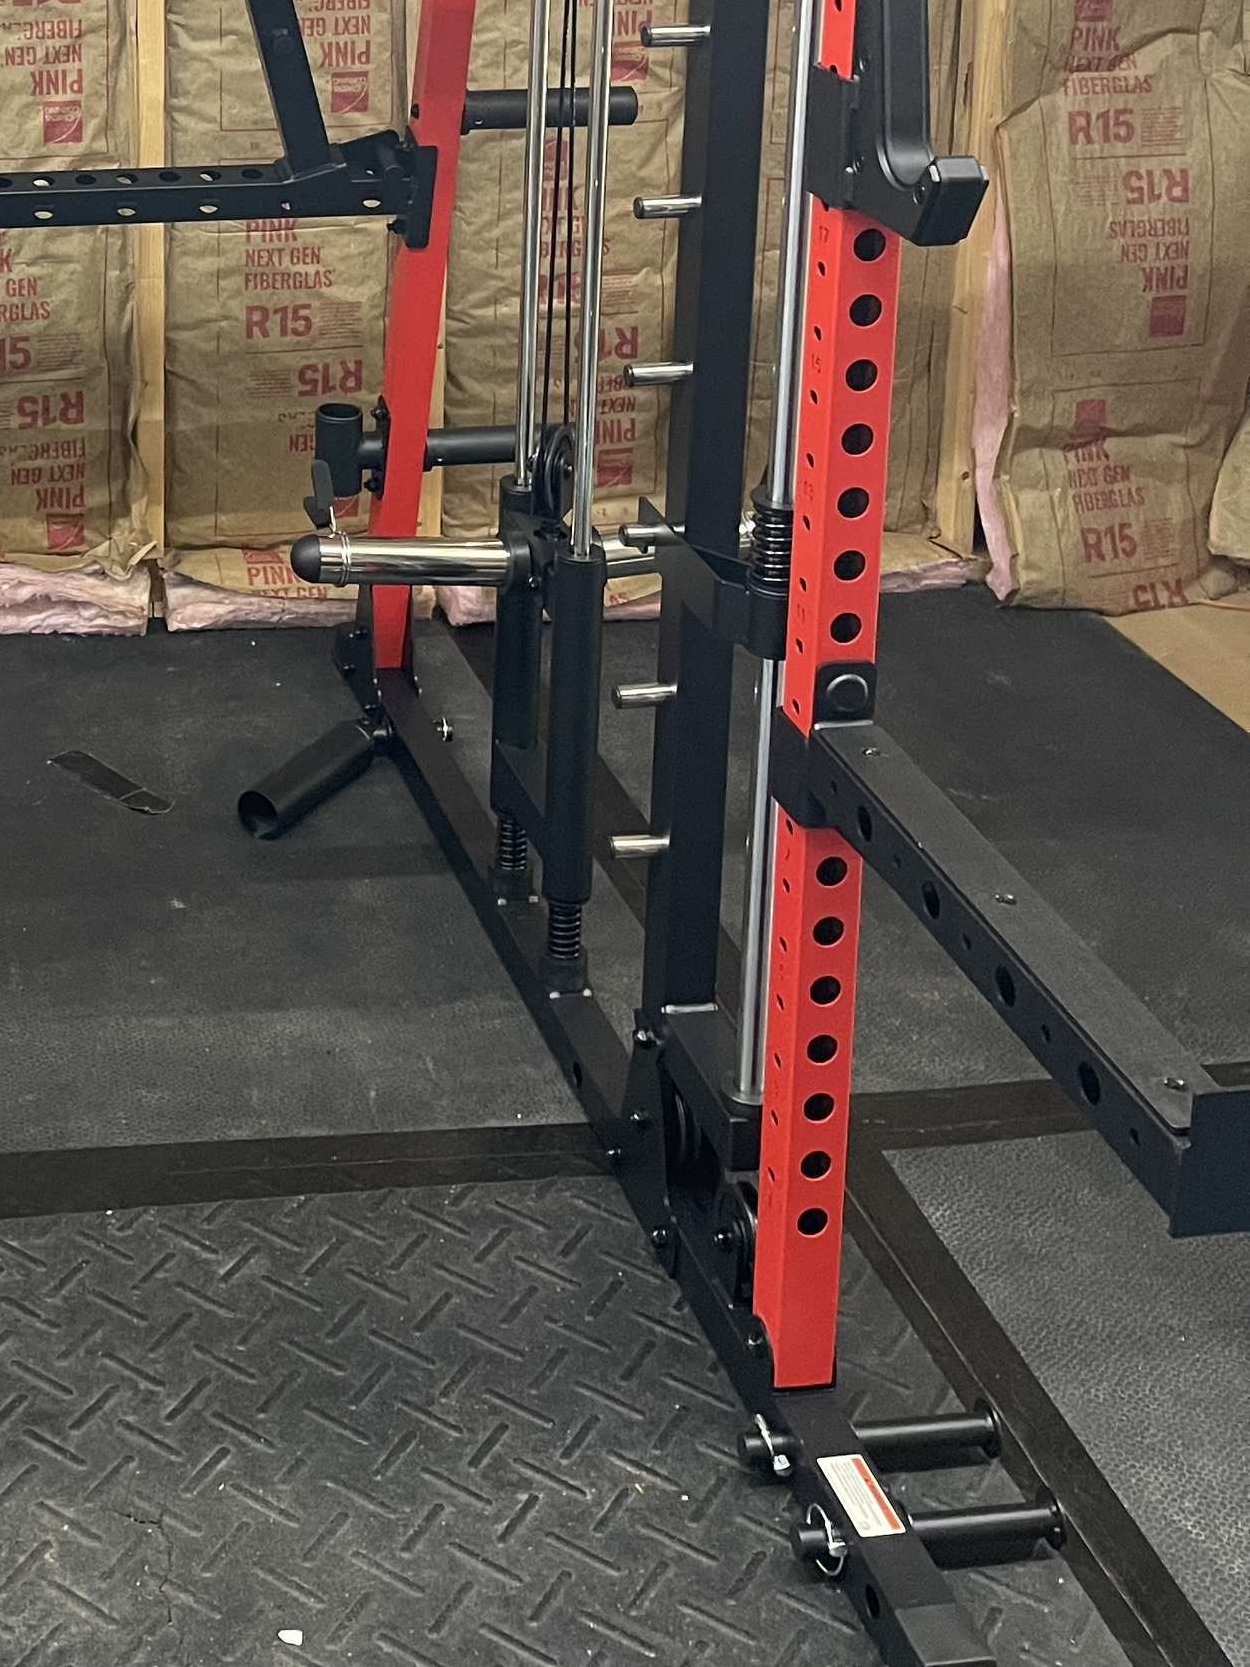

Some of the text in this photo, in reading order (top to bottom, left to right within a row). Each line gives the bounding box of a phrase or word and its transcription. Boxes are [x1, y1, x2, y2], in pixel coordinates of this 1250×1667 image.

[333, 15, 371, 34] NEXT
[1071, 26, 1120, 51] PINK
[4, 45, 82, 66] NEXT GEN
[319, 41, 371, 68] PINK
[30, 69, 83, 96] PINK
[1062, 74, 1152, 96] FIBERGLAS
[1068, 108, 1134, 146] R15
[1121, 168, 1189, 205] R15
[245, 219, 298, 242] PINK
[1109, 218, 1189, 239] FIBERGLAS
[245, 246, 321, 268] NEXT GEN
[1120, 242, 1189, 263] NEXT GEN
[5, 277, 38, 297] GEN
[245, 270, 333, 290] FIBERGLAS
[1141, 266, 1188, 292] PINK
[245, 304, 312, 339] R15
[298, 359, 362, 397] R15
[17, 391, 84, 430] R15
[11, 465, 85, 485] NEXT GEN
[1068, 465, 1130, 488] NEXT GEN
[36, 488, 85, 511] PINK
[1073, 486, 1146, 514] FIBERGLAS
[1080, 523, 1137, 563] R15
